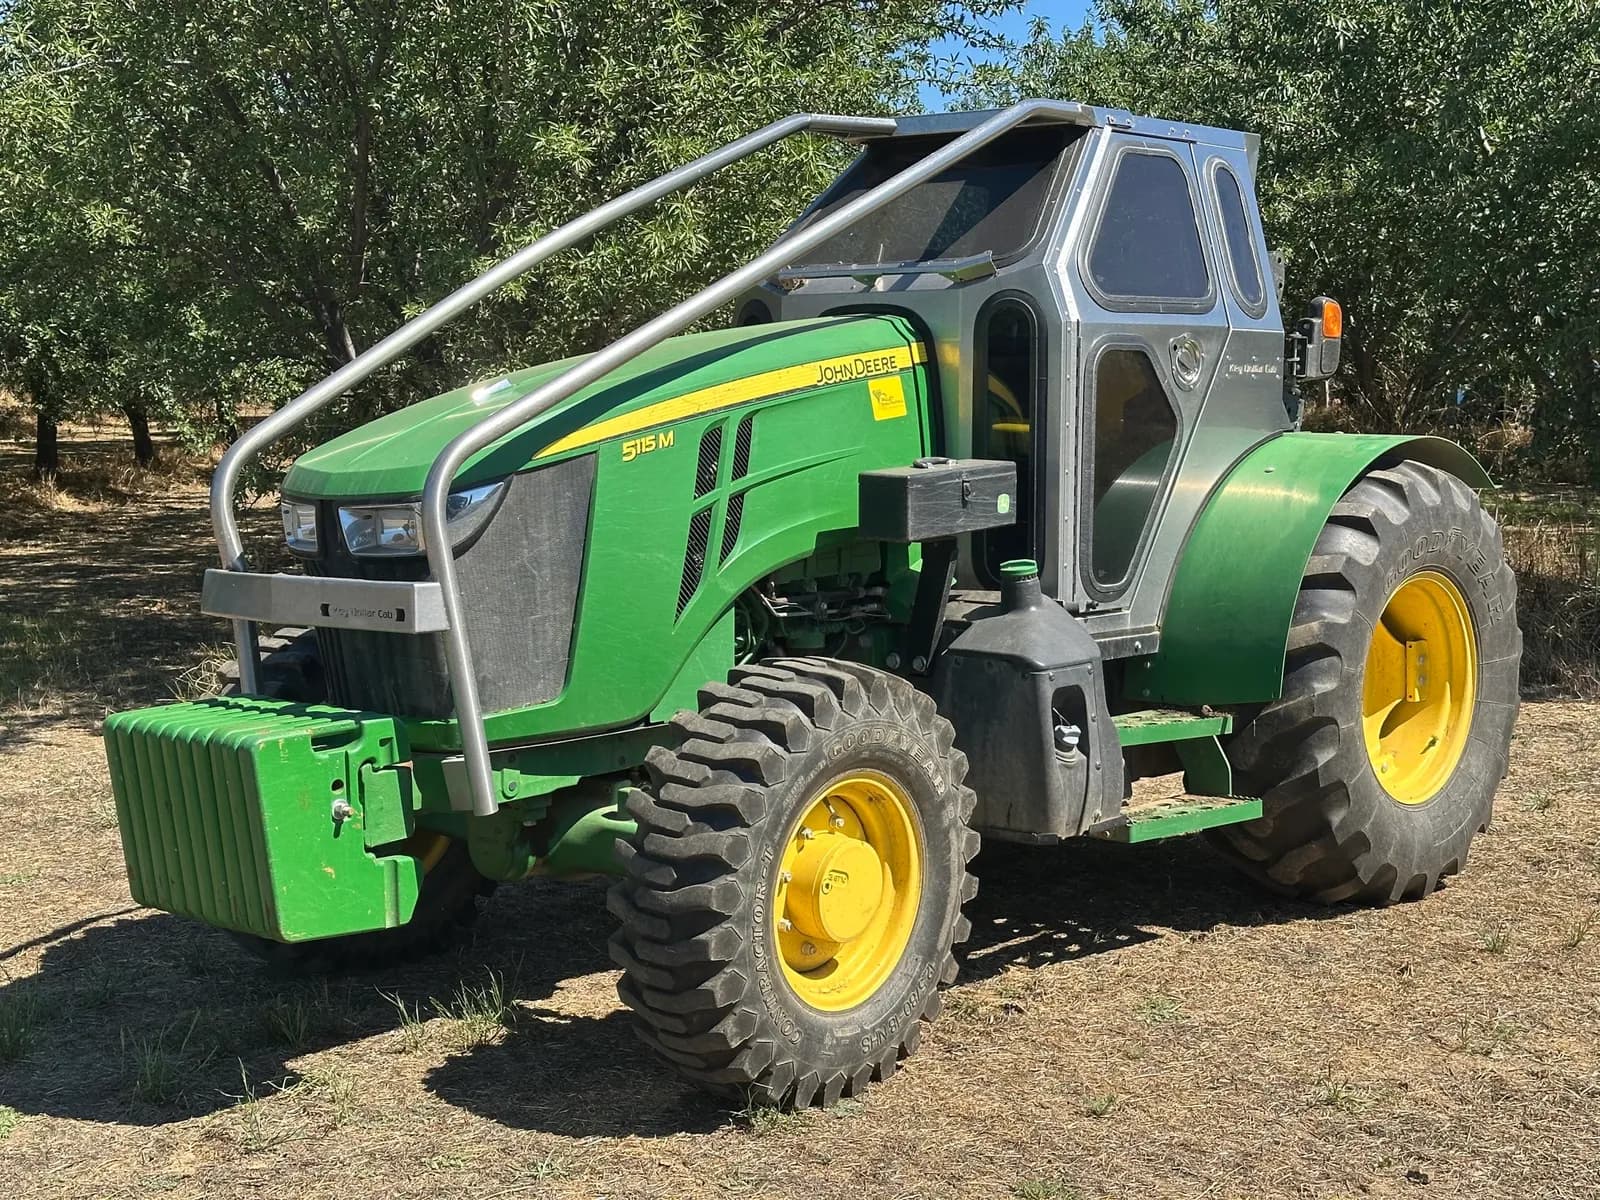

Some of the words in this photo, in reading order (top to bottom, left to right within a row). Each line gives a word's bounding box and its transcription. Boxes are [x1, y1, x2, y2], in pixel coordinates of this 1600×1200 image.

[817, 364, 853, 384] JOHN
[854, 356, 897, 376] DEERE
[622, 435, 656, 462] 5115
[659, 430, 675, 449] M
[1384, 526, 1504, 626] GOODYEAR
[827, 727, 946, 797] GOODYEAR
[751, 843, 803, 1046] CONTRACTOR-T
[861, 1026, 889, 1055] NHS
